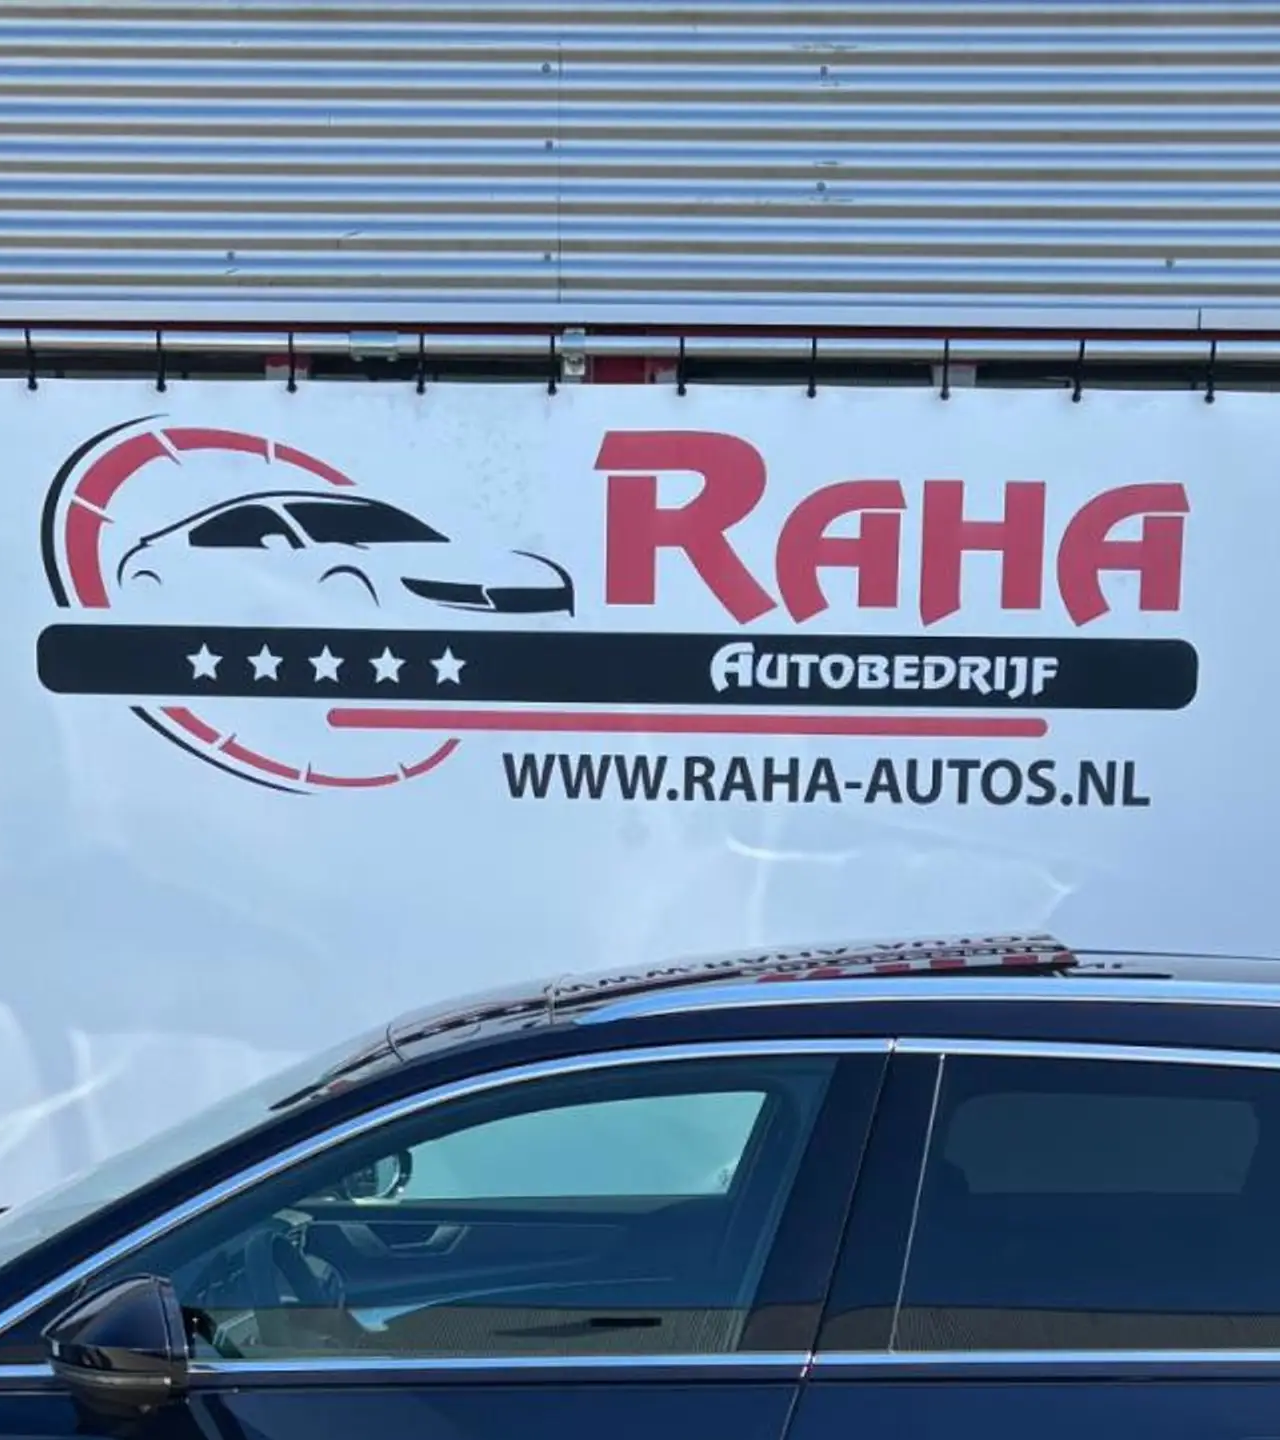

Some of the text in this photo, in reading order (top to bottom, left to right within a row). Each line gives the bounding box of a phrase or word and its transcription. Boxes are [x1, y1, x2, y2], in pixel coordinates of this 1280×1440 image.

[594, 430, 1190, 626] RAHA
[710, 641, 1059, 699] AUTOBEDRIJF
[501, 752, 1151, 808] WWW.RAHA-AUTOS.NL
